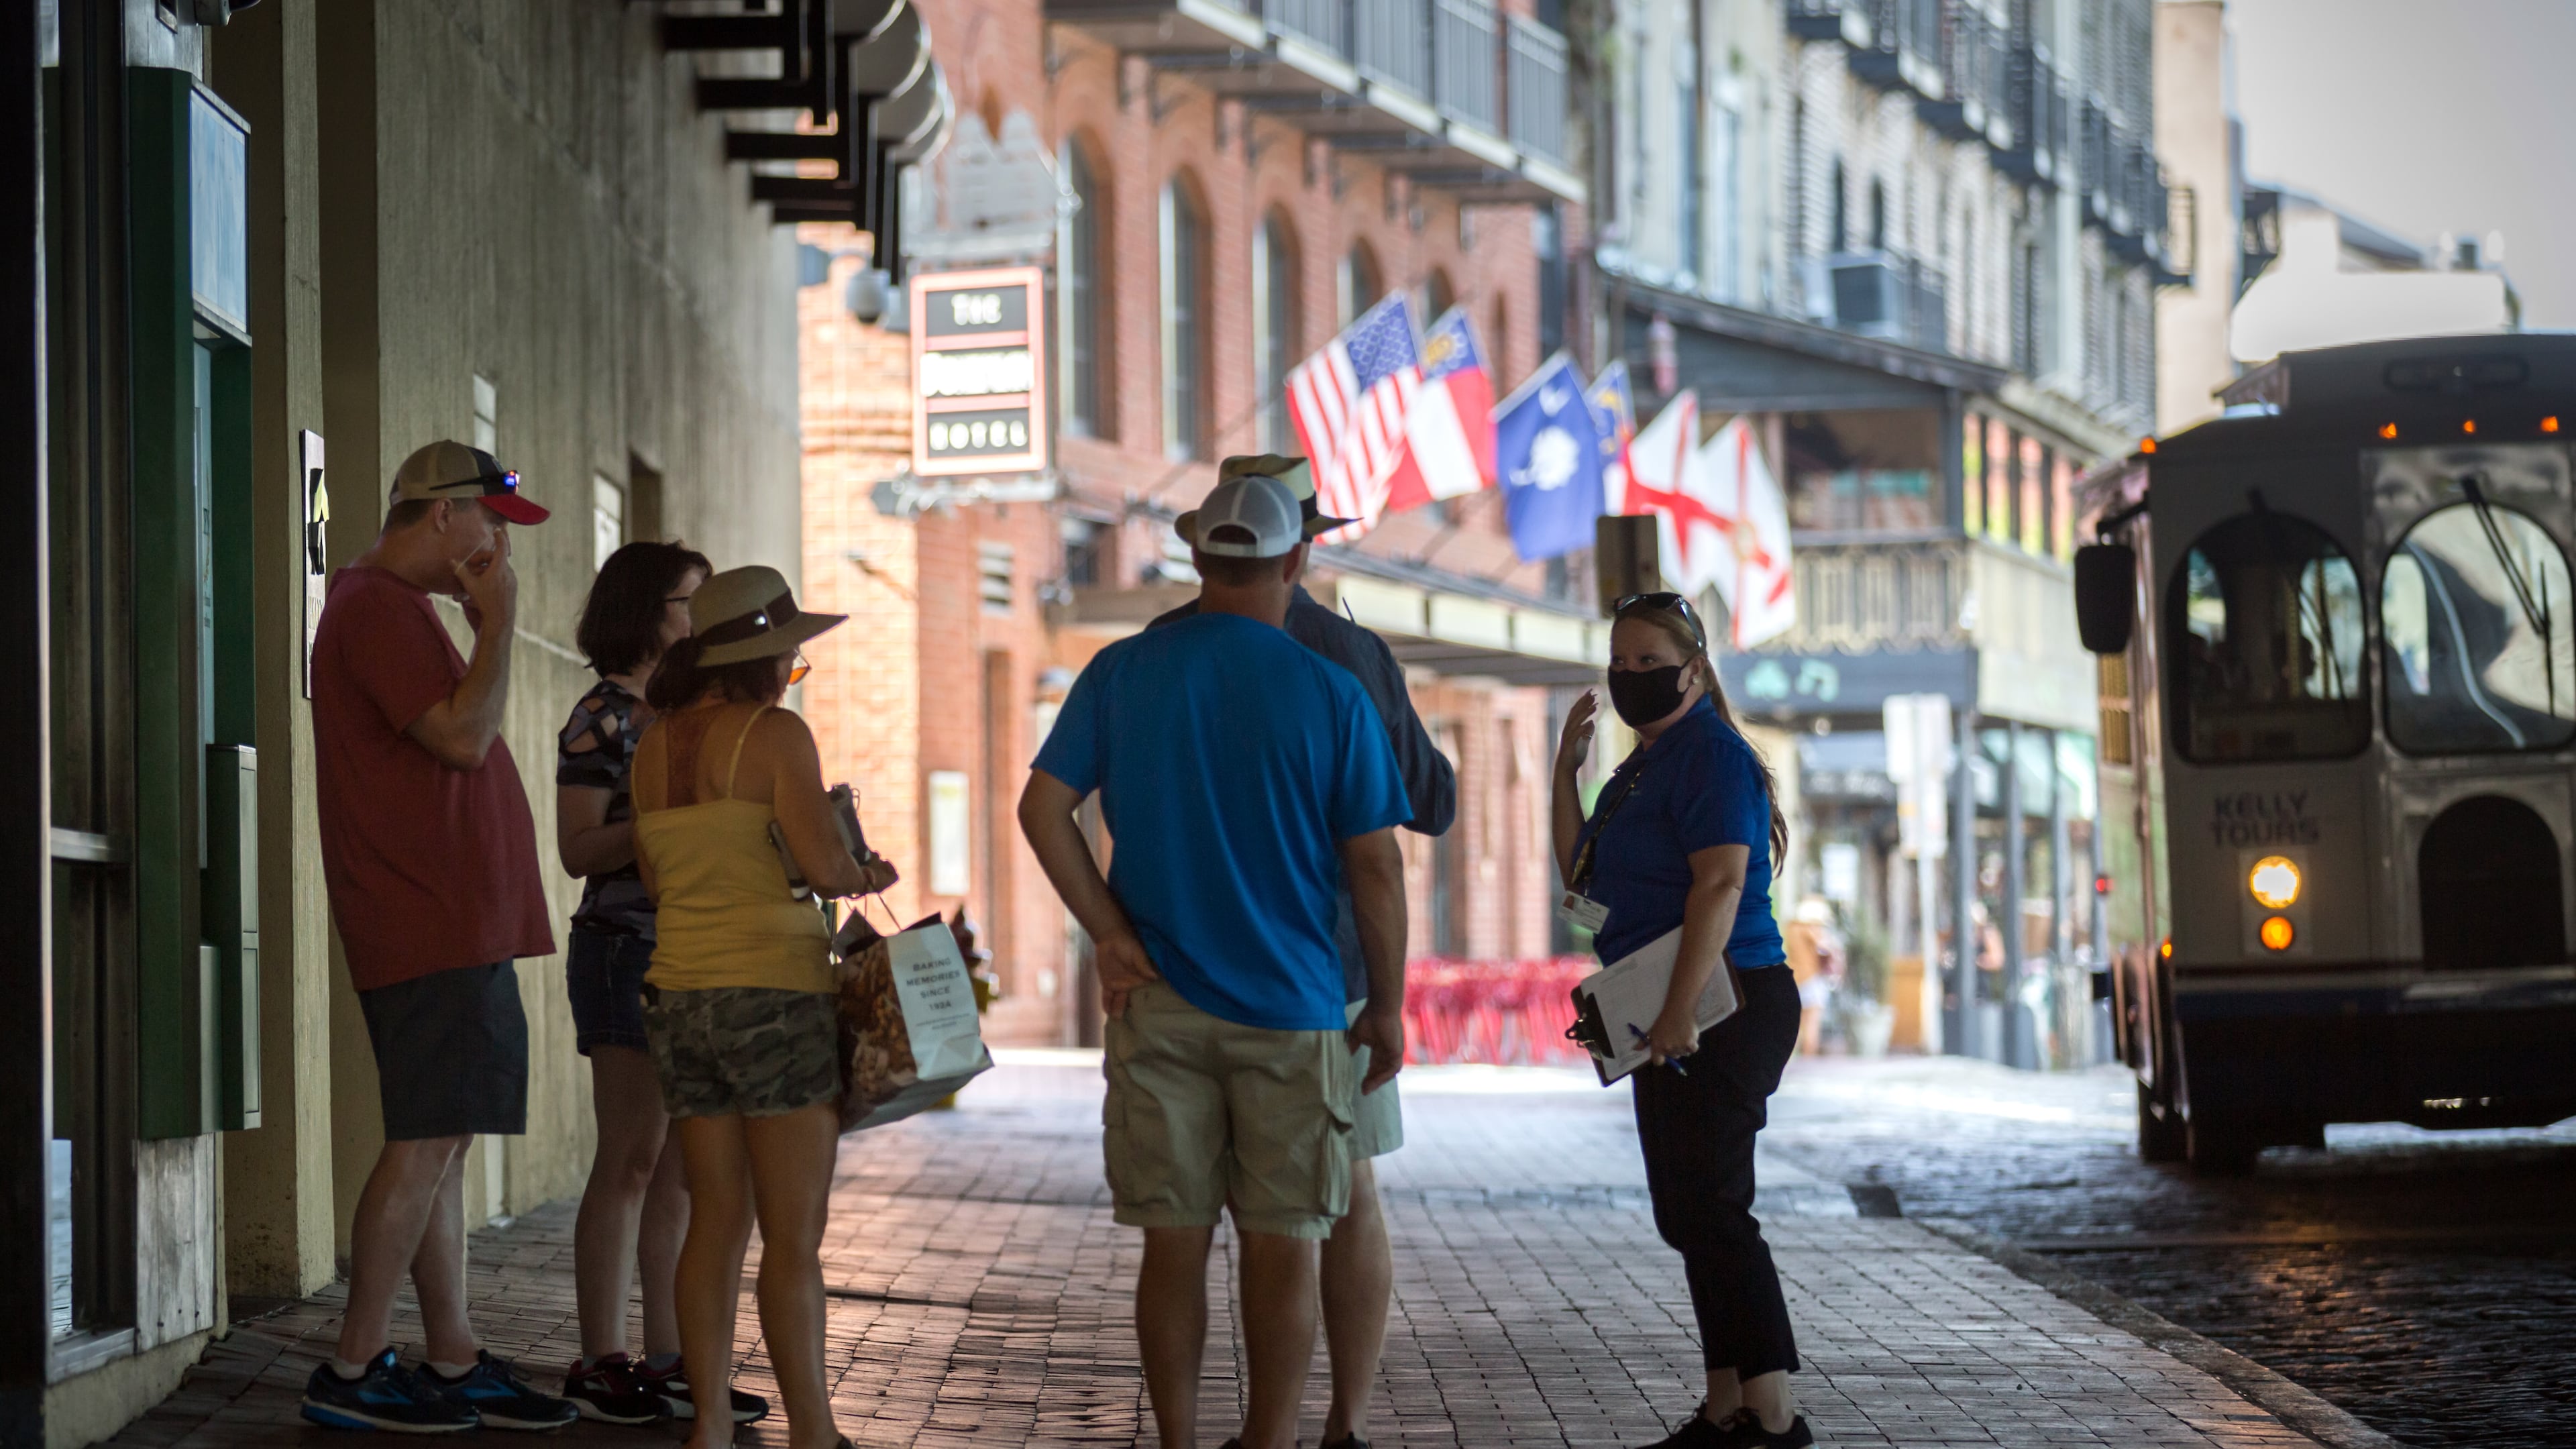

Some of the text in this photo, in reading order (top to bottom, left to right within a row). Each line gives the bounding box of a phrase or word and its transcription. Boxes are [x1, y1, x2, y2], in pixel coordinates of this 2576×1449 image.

[2214, 791, 2308, 818] KELLY
[2210, 817, 2319, 846] TOURS
[913, 957, 952, 971] BAKING
[906, 970, 960, 987] MEMORIES
[920, 986, 950, 999] SINCE
